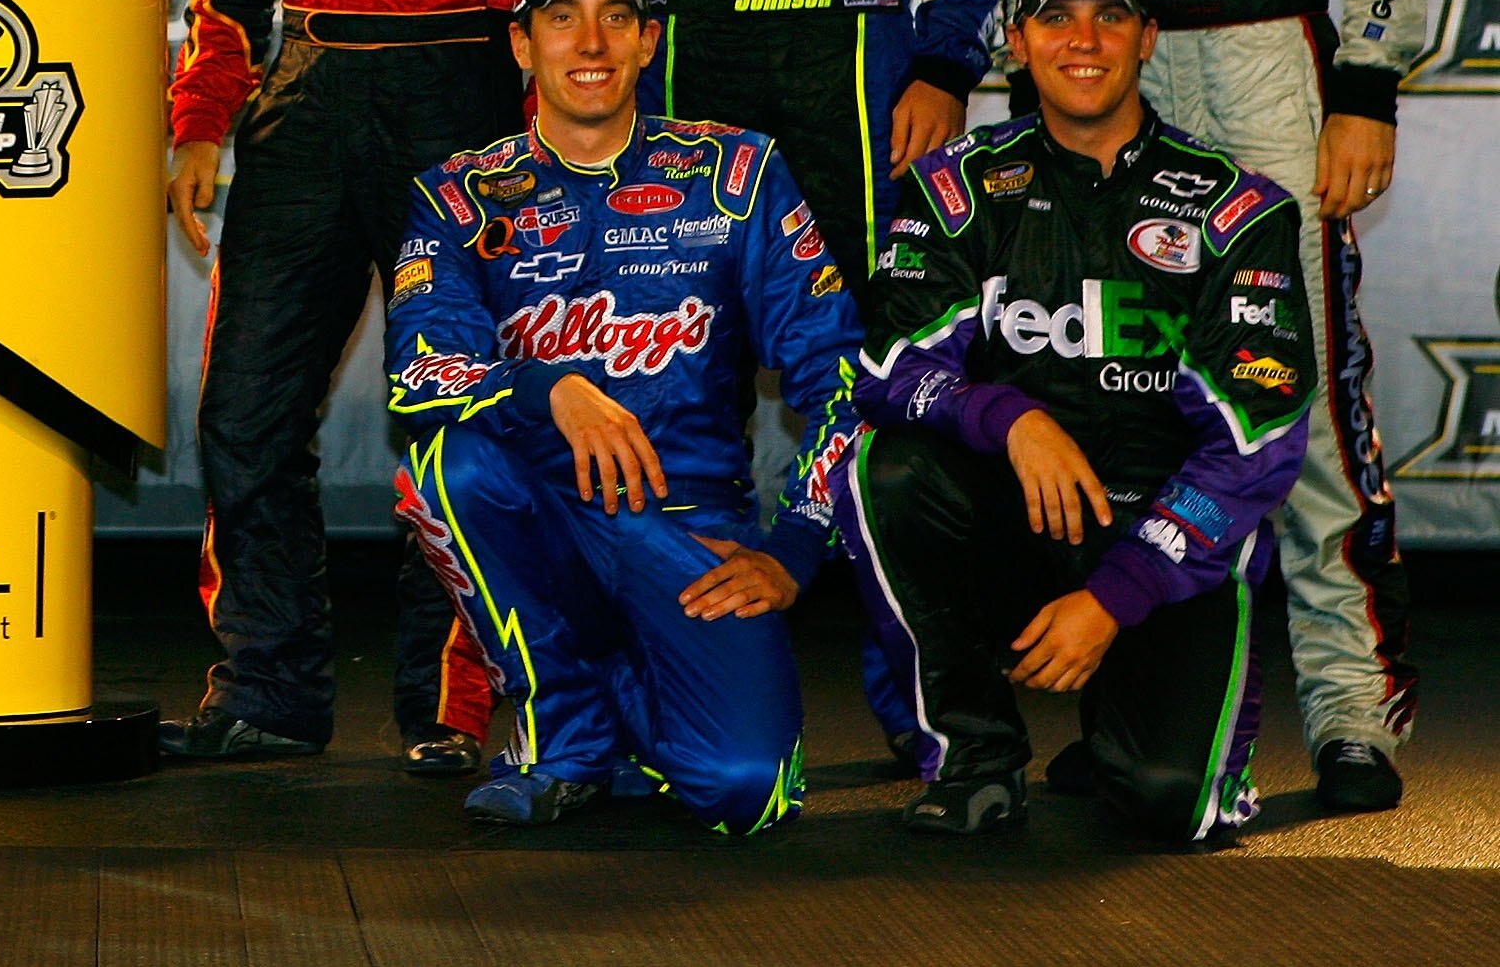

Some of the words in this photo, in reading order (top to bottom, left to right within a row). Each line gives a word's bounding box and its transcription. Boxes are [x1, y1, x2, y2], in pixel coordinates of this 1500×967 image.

[664, 164, 712, 180] Racing
[438, 182, 474, 225] SIMPSON
[615, 194, 674, 205] DELPHI
[1139, 193, 1206, 219] GOODYEA
[515, 207, 580, 231] CARQUEST
[672, 214, 733, 238] Hendrick
[604, 226, 669, 246] GMAC
[400, 238, 441, 258] MAC
[618, 260, 710, 277] GOODYEAR
[890, 267, 926, 280] Ground
[982, 276, 1191, 359] FedEx
[498, 291, 713, 376] Kellogg's
[1099, 361, 1179, 392] Grou
[1233, 363, 1298, 382] SUNOCO
